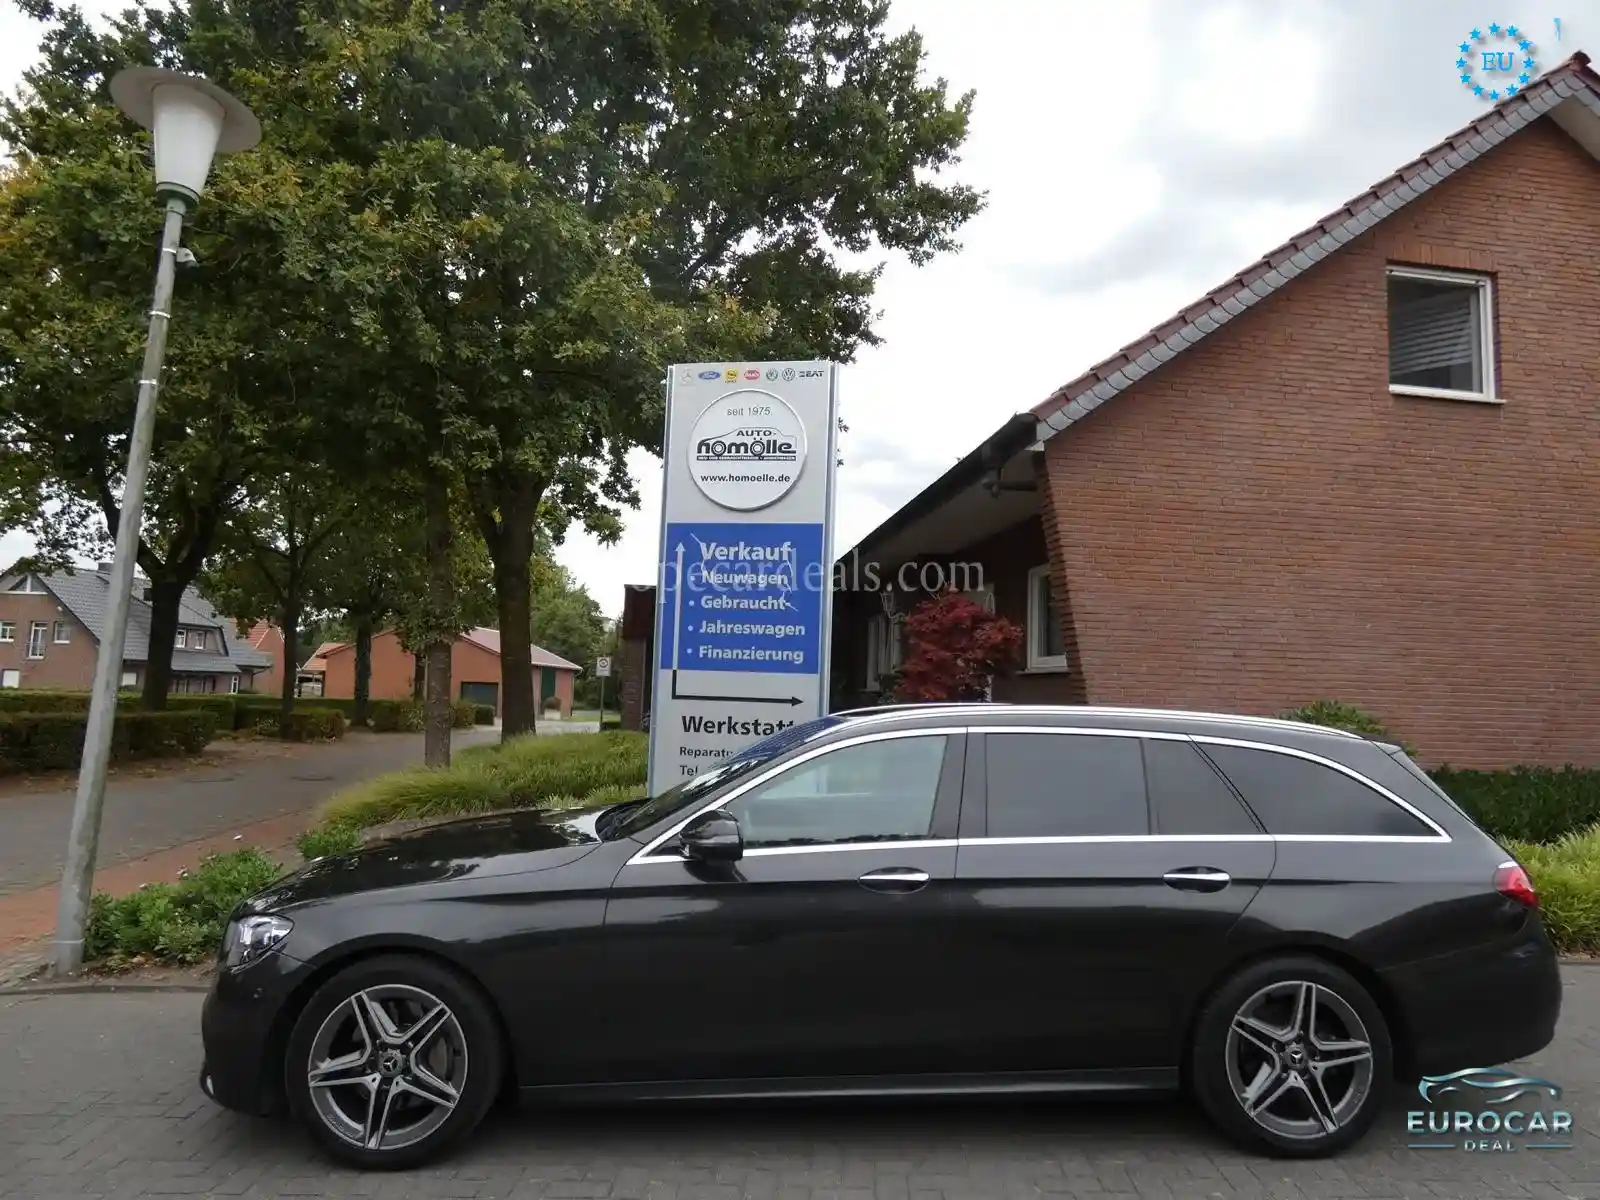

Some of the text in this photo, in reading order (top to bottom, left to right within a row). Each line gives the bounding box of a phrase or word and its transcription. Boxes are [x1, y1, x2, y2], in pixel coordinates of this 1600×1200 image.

[727, 406, 772, 417] seit 1975
[700, 473, 791, 483] www.homoelle.de
[699, 541, 792, 562] Verkauf
[702, 570, 789, 588] Neuwagen
[699, 620, 806, 638] Jahreswagen
[699, 645, 804, 664] Finanzierung
